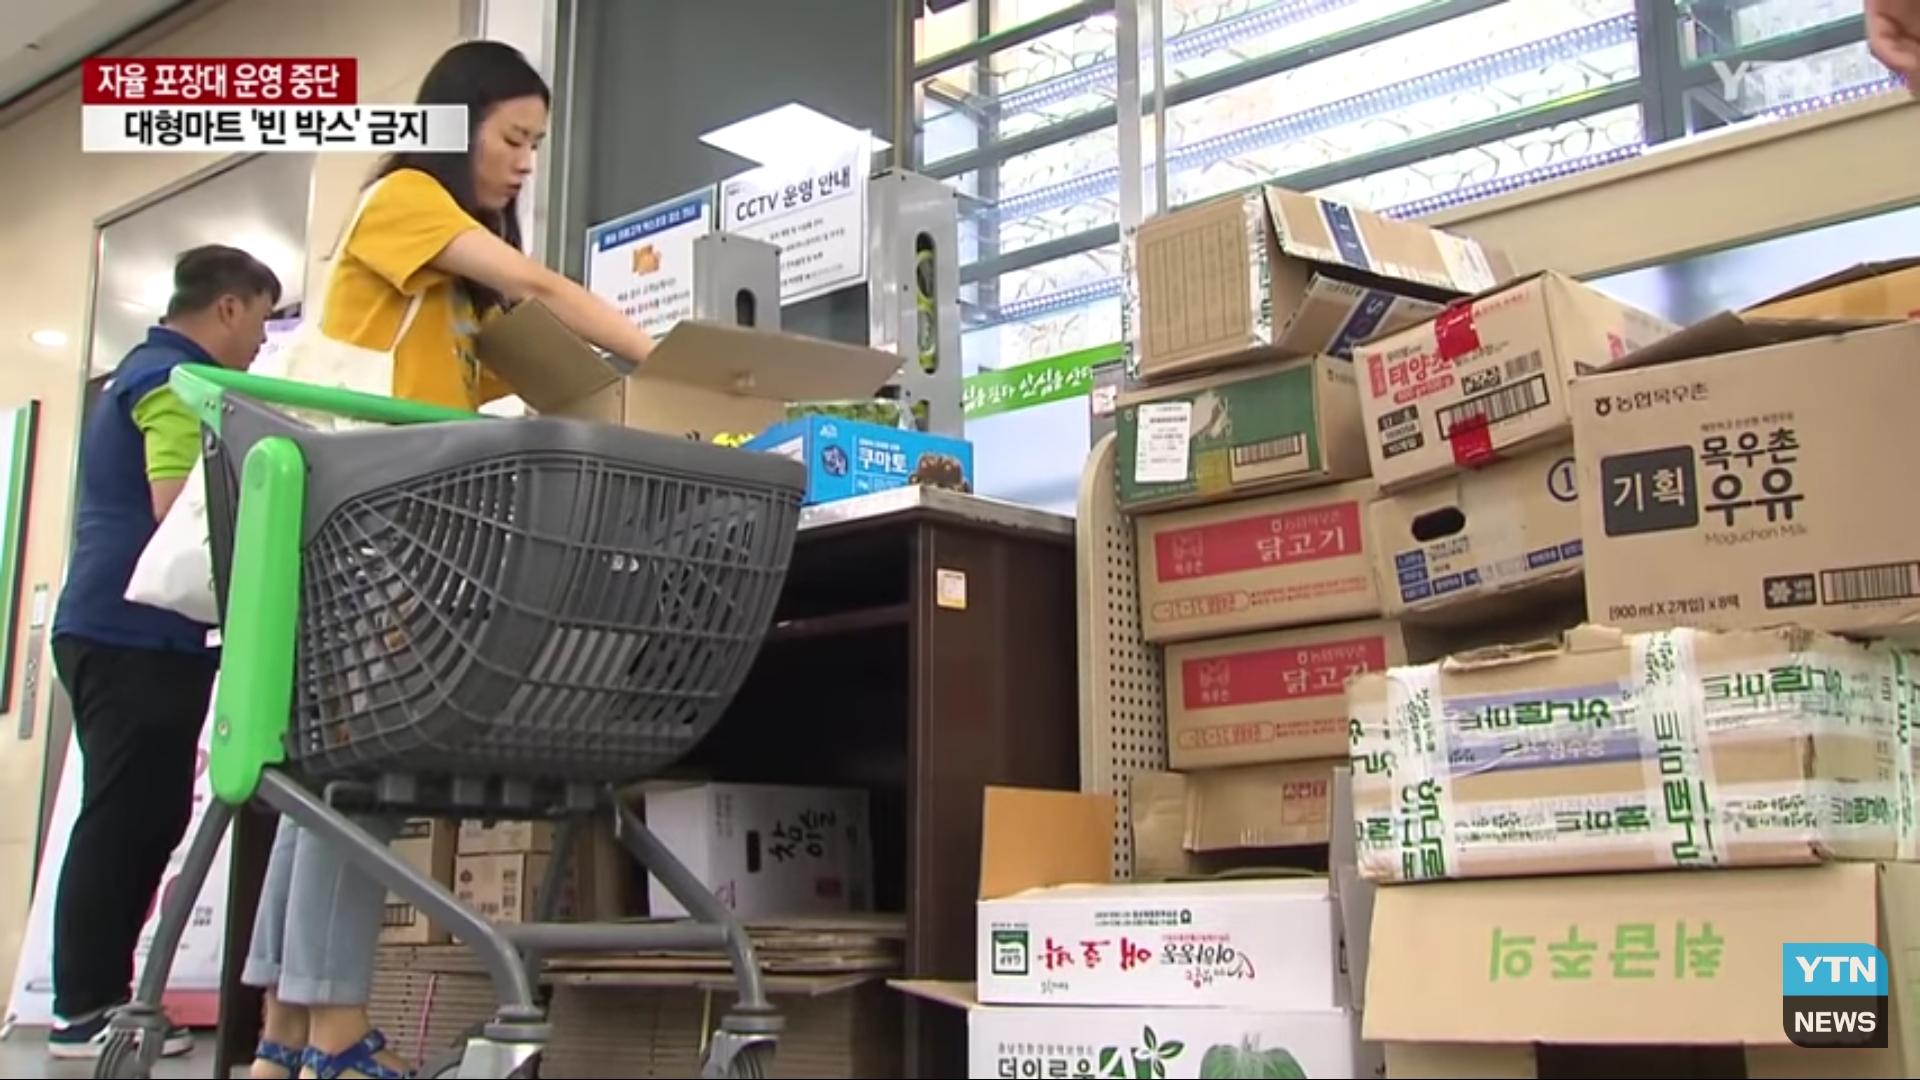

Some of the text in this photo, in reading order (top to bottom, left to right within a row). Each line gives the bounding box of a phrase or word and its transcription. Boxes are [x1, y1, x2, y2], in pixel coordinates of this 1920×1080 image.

[736, 165, 851, 221] CCTV 운영 안내
[1616, 383, 1709, 412] 농협목우촌
[858, 447, 908, 474] 쿠마토
[1700, 427, 1799, 469] 목우촌
[1613, 466, 1685, 512] 기획
[1704, 468, 1805, 527] 우유
[1256, 526, 1344, 563] 닭고기
[1458, 698, 1611, 731] 하나로마트
[768, 818, 803, 863] 참
[1080, 941, 1111, 969] 호
[1120, 937, 1152, 971] 애
[1489, 918, 1725, 983] 취급주의
